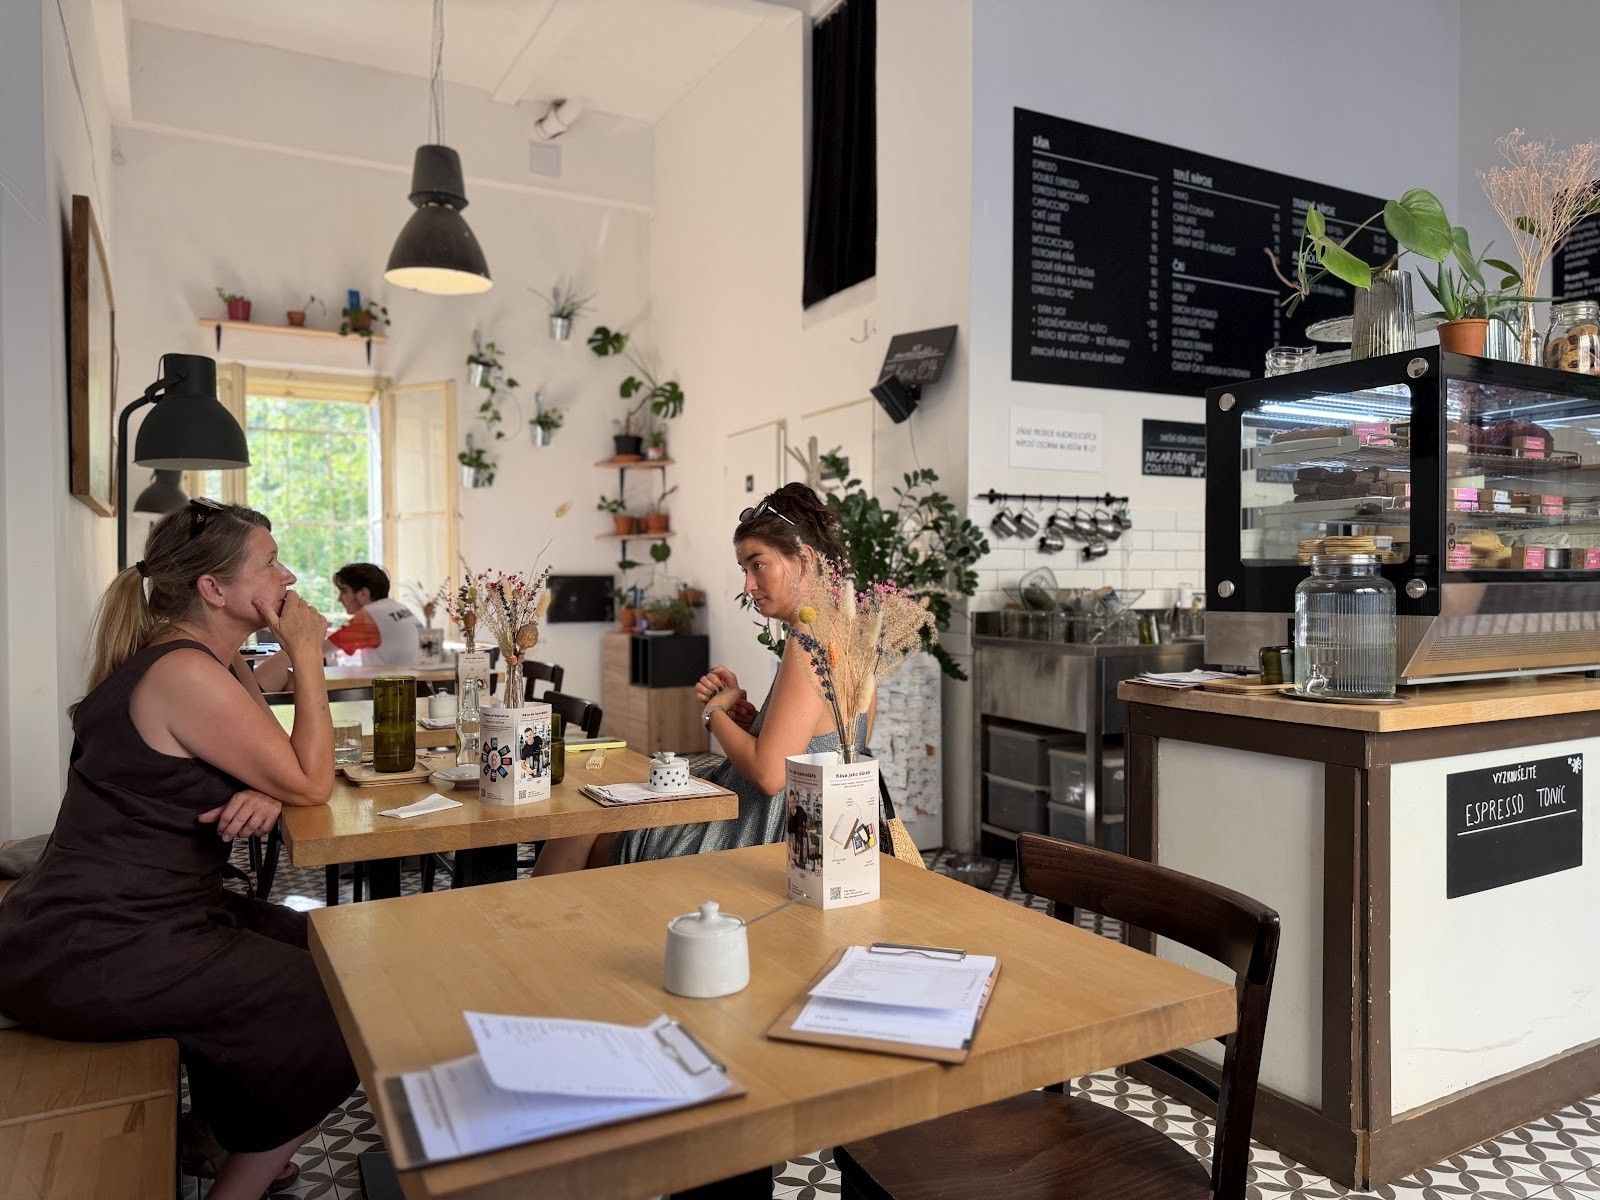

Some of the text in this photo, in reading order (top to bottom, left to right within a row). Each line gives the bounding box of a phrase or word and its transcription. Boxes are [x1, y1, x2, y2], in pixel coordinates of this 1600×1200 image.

[1492, 765, 1536, 784] VYZKOUŠEJTE
[1466, 785, 1566, 826] ESPRESSO TONIC
